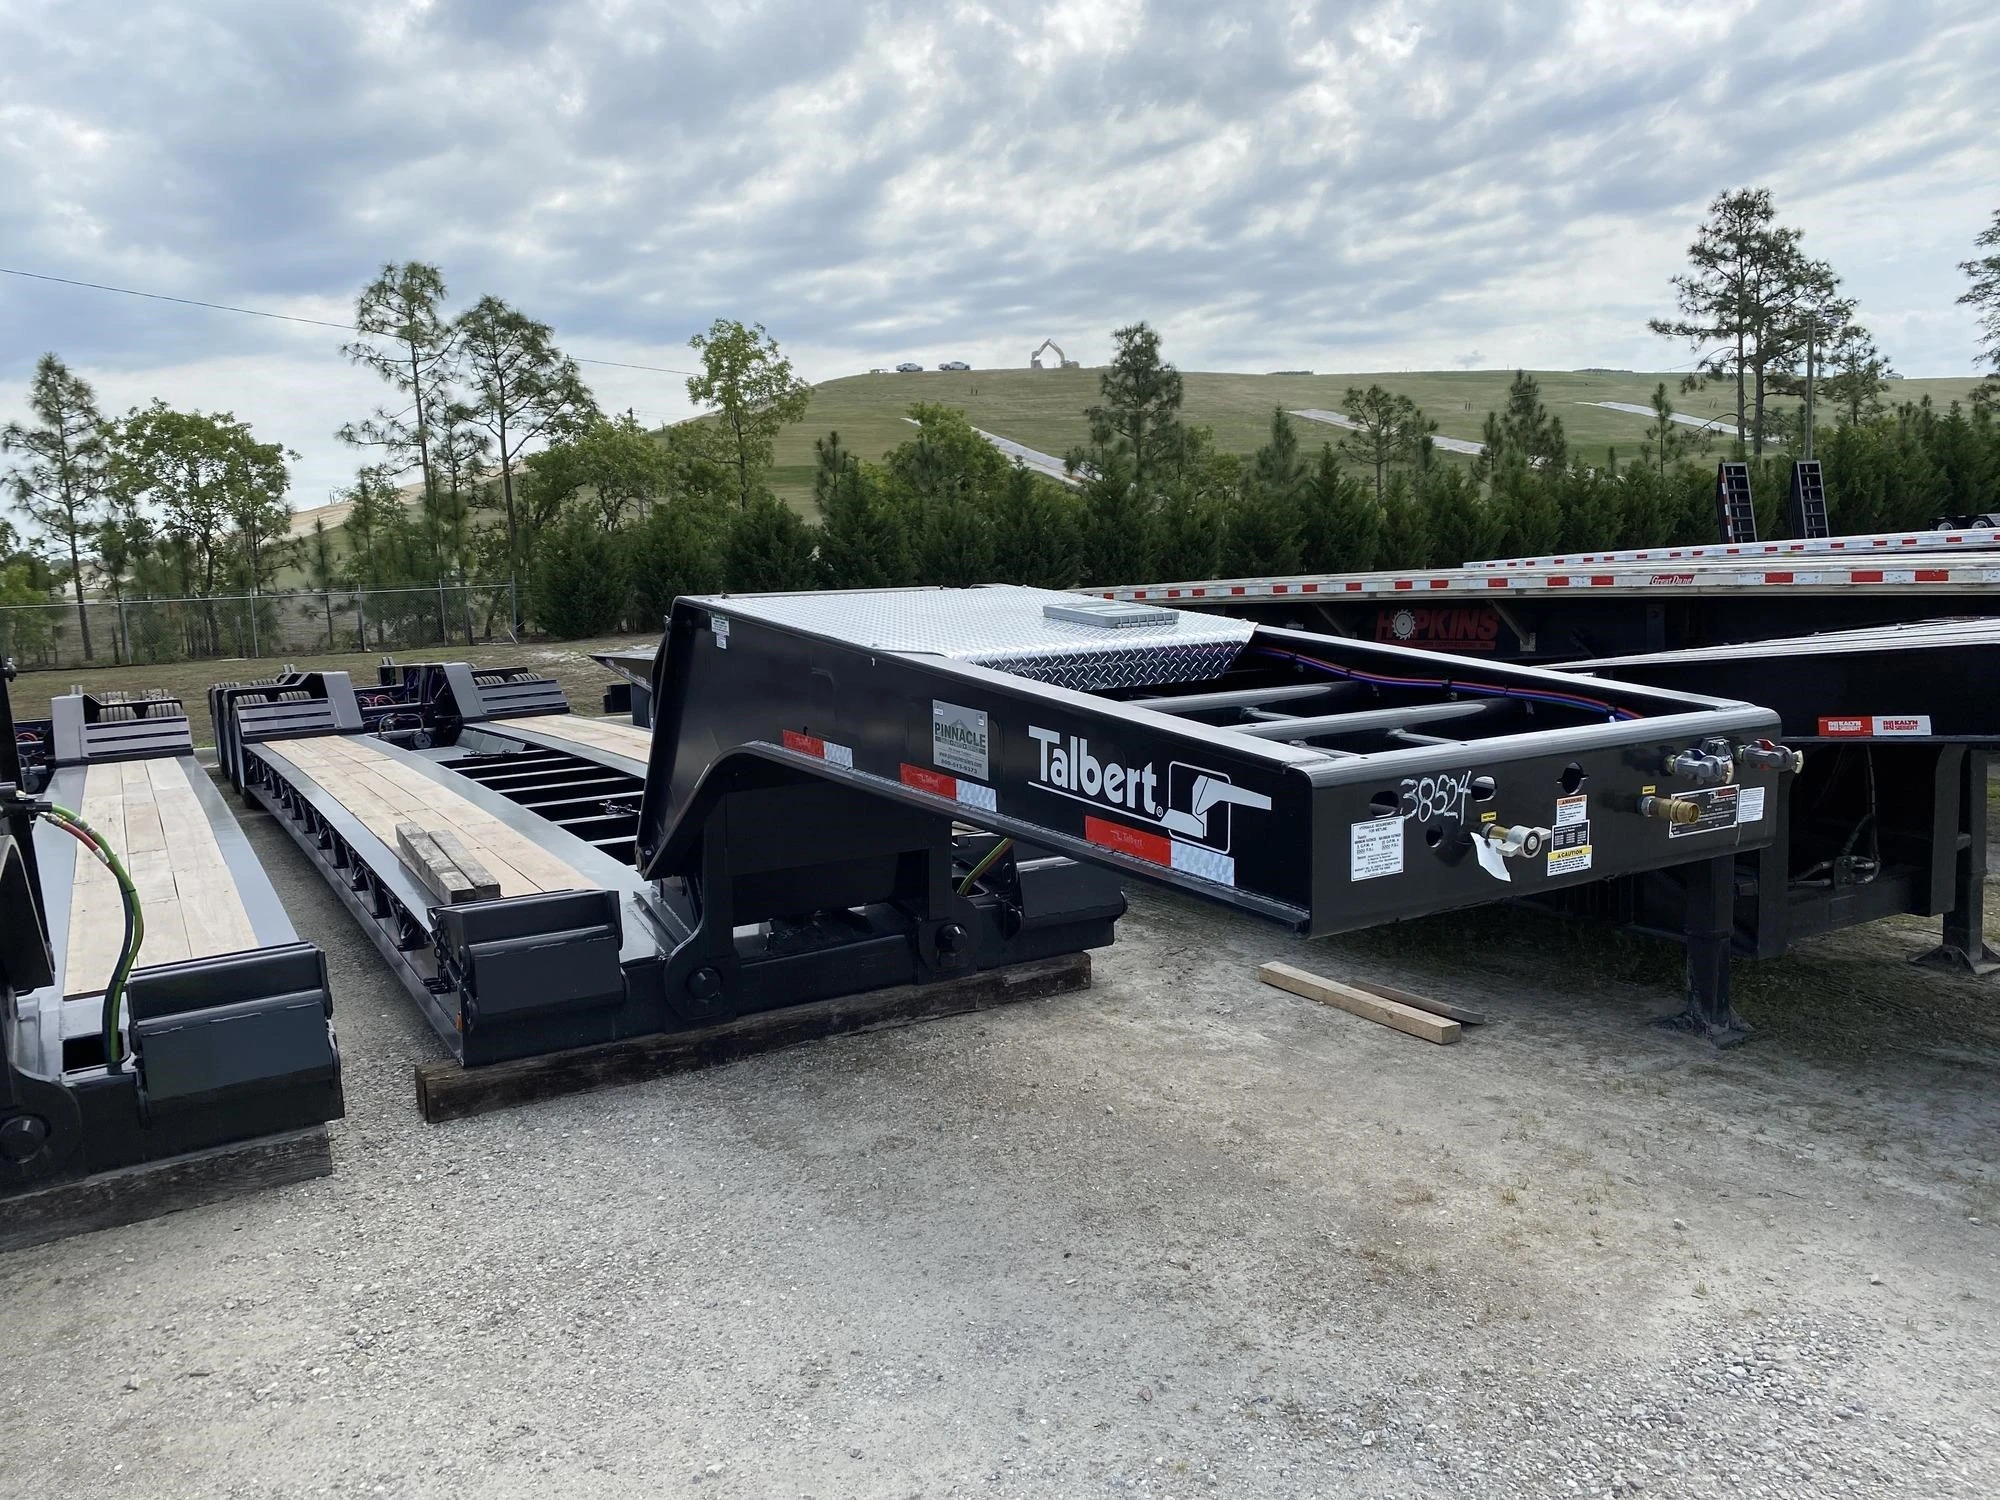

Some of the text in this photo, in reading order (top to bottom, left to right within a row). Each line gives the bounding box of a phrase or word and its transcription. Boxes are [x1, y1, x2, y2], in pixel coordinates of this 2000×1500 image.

[1651, 575, 1692, 585] Great Dane
[934, 722, 986, 749] PINNACLE
[1028, 725, 1158, 816] Talbert
[1400, 770, 1472, 826] 38524
[1561, 849, 1583, 858] CAUTION
